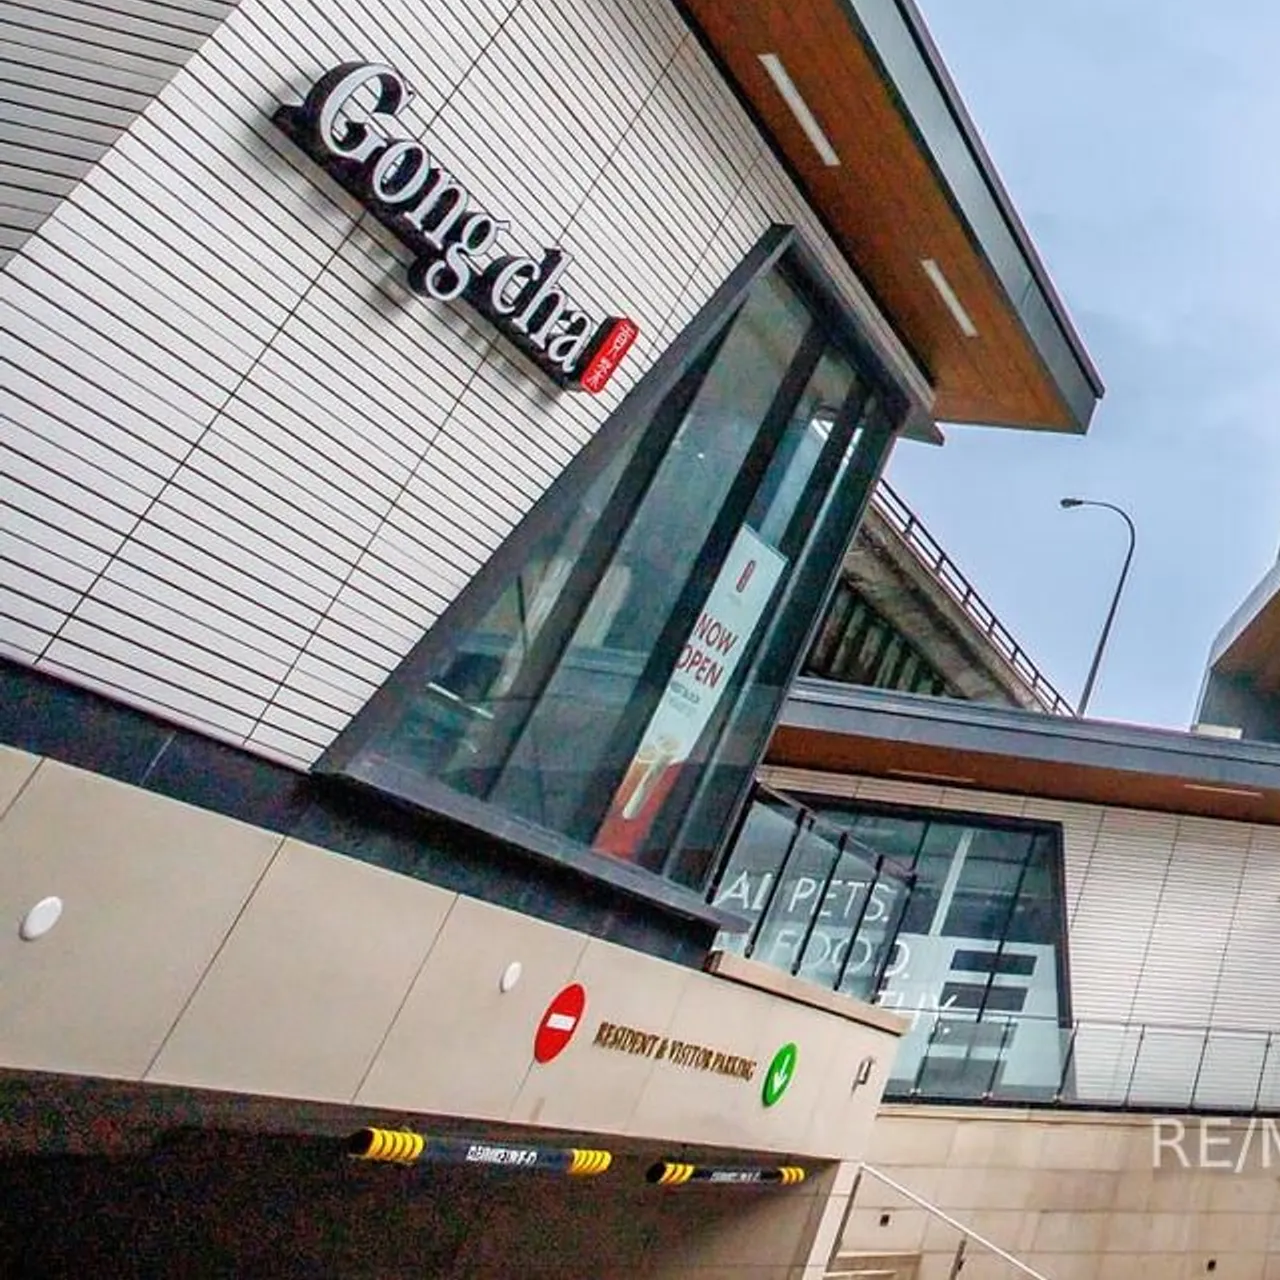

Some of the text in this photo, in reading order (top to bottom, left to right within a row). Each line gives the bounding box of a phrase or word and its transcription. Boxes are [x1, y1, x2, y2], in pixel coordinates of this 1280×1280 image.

[312, 61, 592, 373] Gong cha
[694, 613, 739, 657] NOW
[674, 643, 725, 689] OPEN
[594, 1021, 660, 1058] RESIDENT
[668, 1039, 714, 1071] VISITOR
